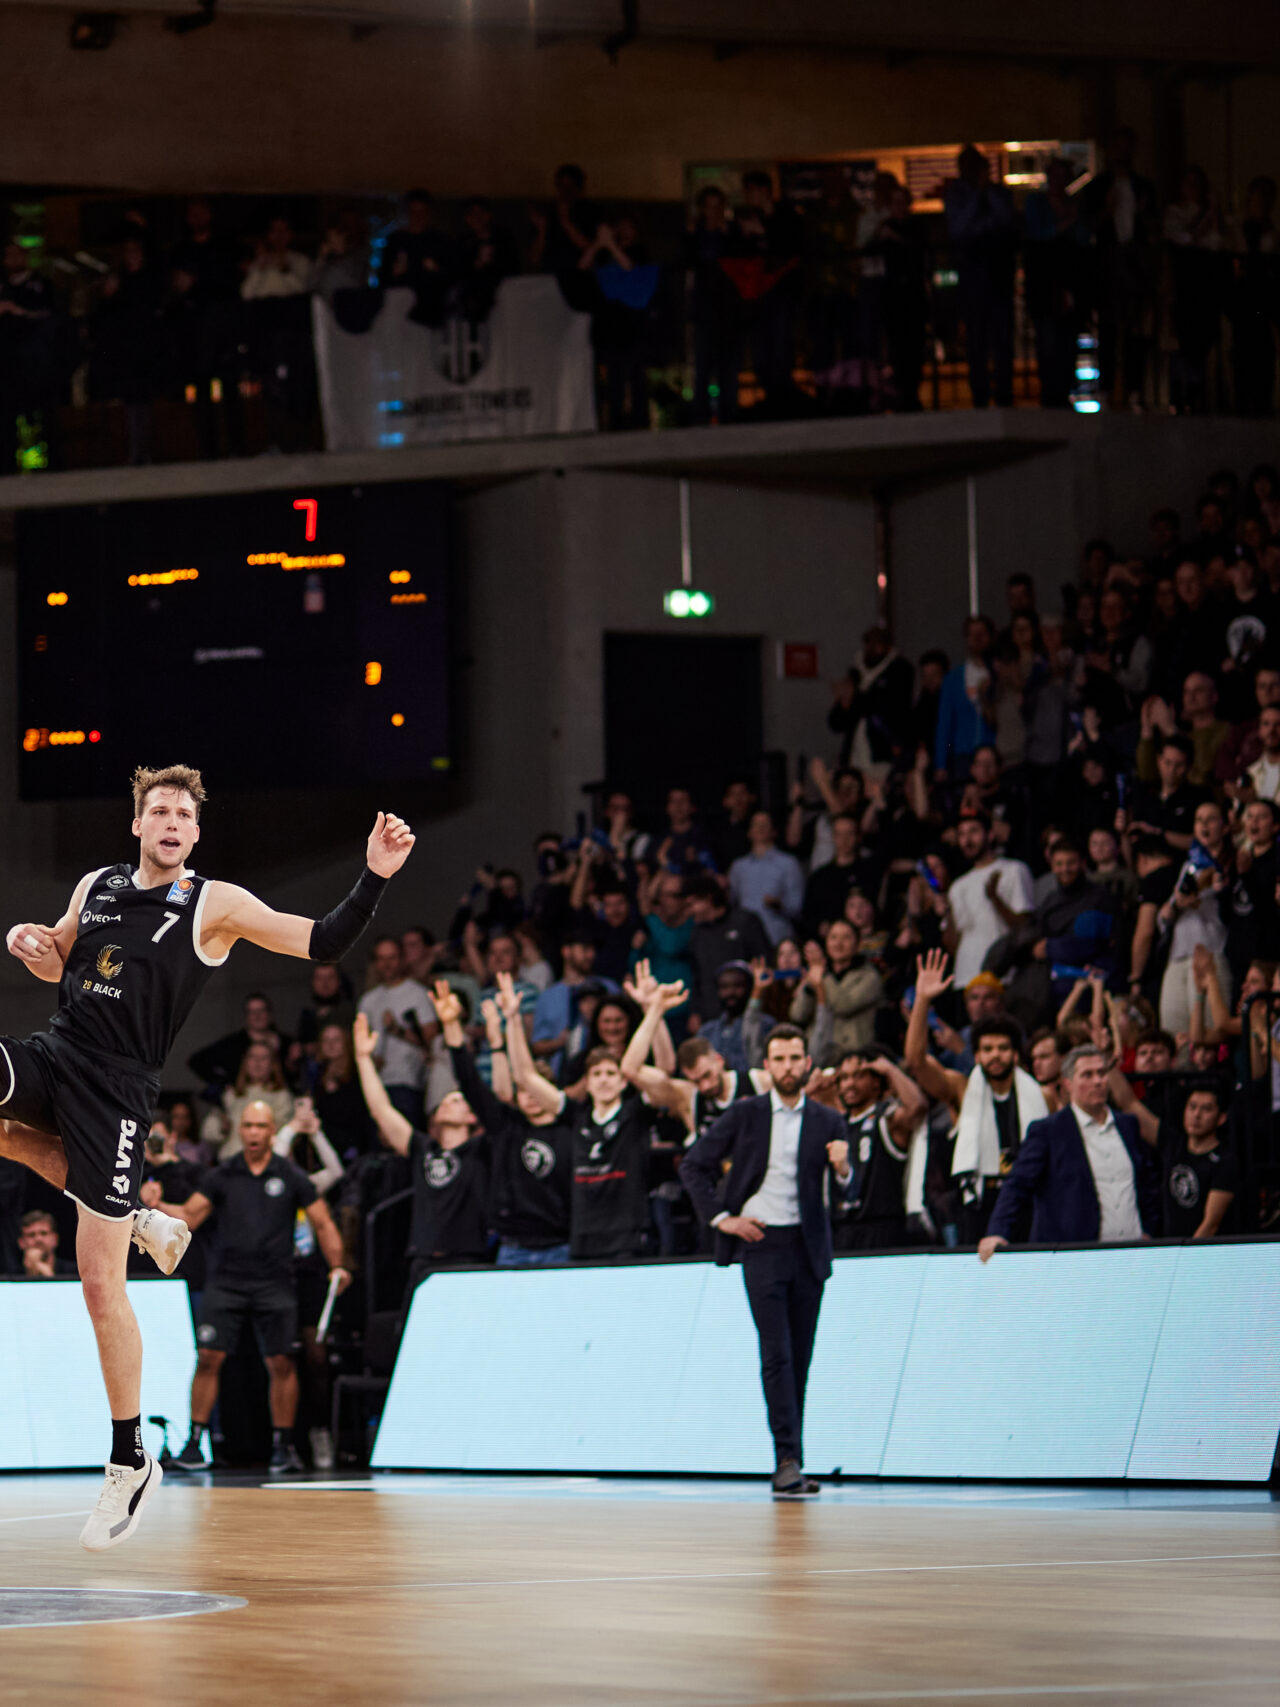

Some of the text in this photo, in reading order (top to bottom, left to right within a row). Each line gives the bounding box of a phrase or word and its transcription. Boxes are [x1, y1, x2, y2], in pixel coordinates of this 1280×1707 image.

[293, 498, 318, 542] 7
[91, 914, 122, 923] VEOA
[151, 911, 181, 944] 7
[82, 979, 122, 999] 28 BLACK
[115, 1118, 137, 1169] VTG
[104, 1194, 128, 1206] CRAFT
